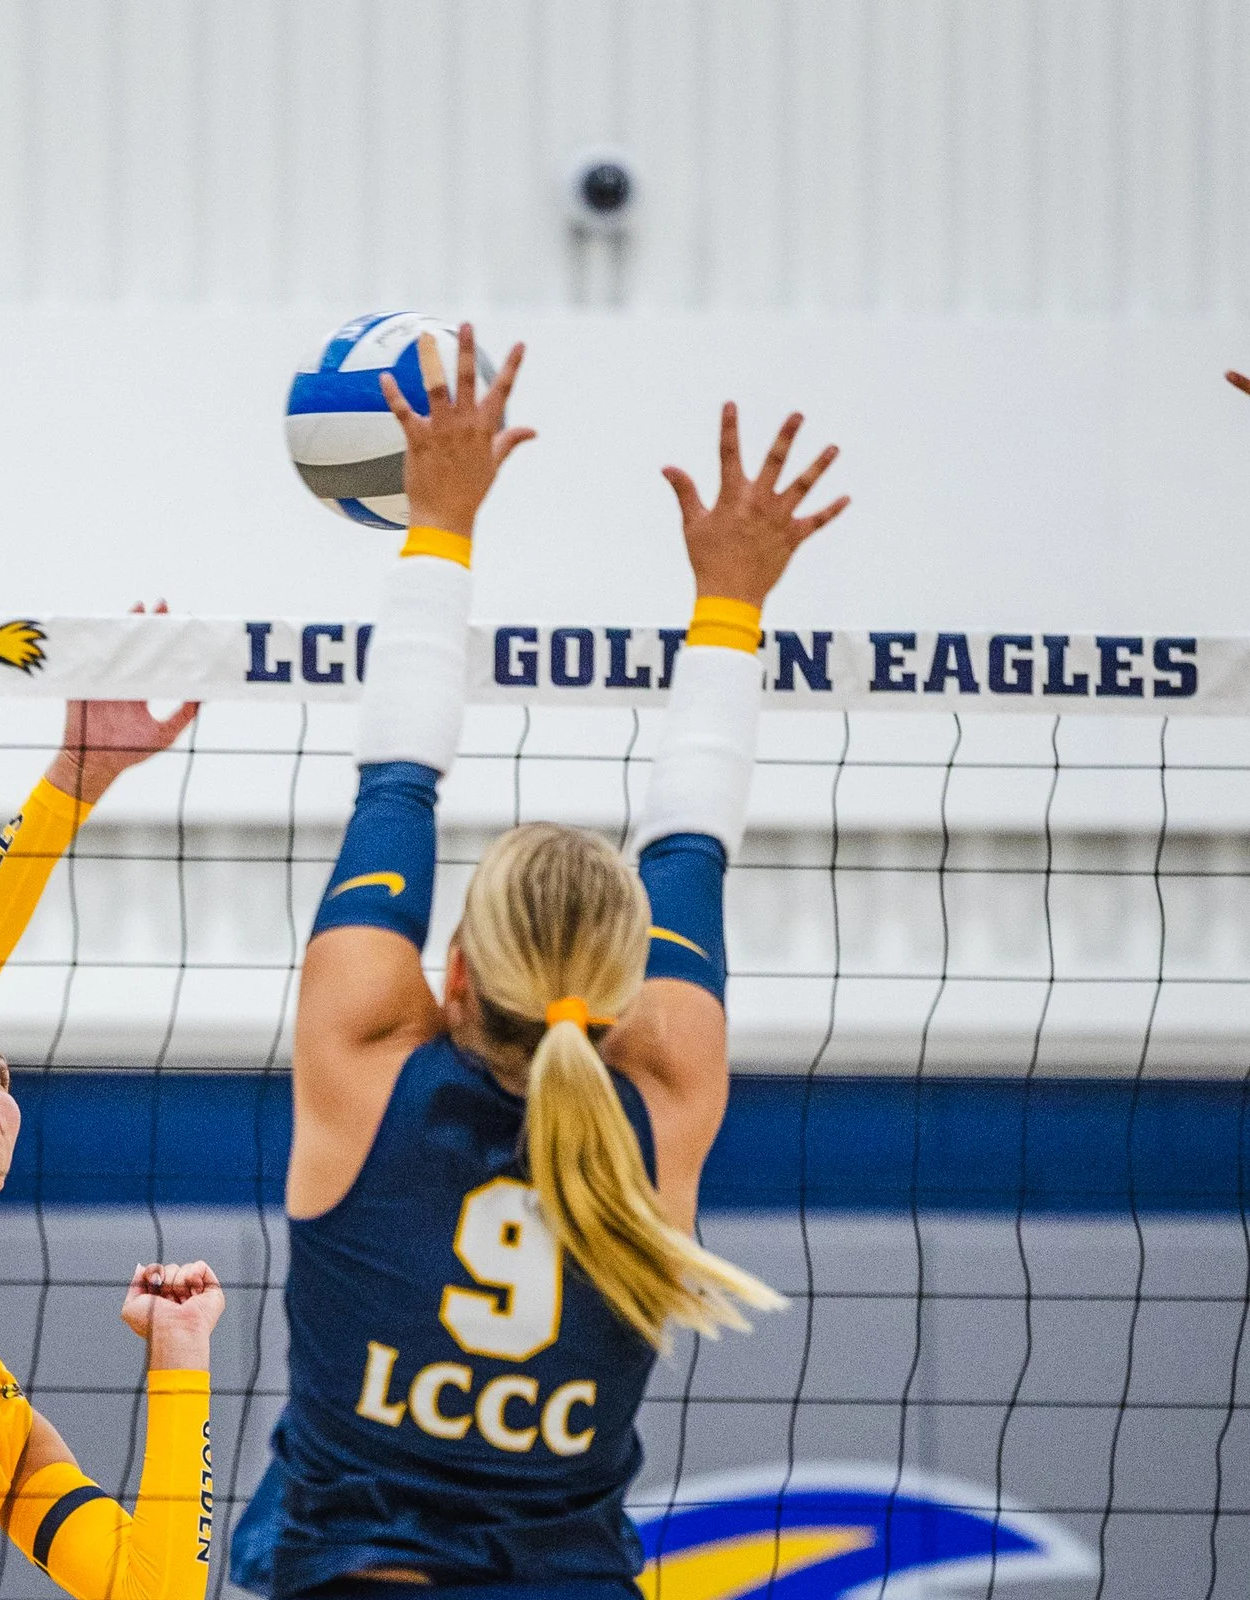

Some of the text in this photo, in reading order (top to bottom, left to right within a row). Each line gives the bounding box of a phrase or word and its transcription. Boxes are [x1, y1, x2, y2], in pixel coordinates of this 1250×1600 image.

[245, 622, 1199, 699] LC GOLN EAGLES
[439, 1176, 564, 1362] 9
[355, 1340, 598, 1457] LCCC
